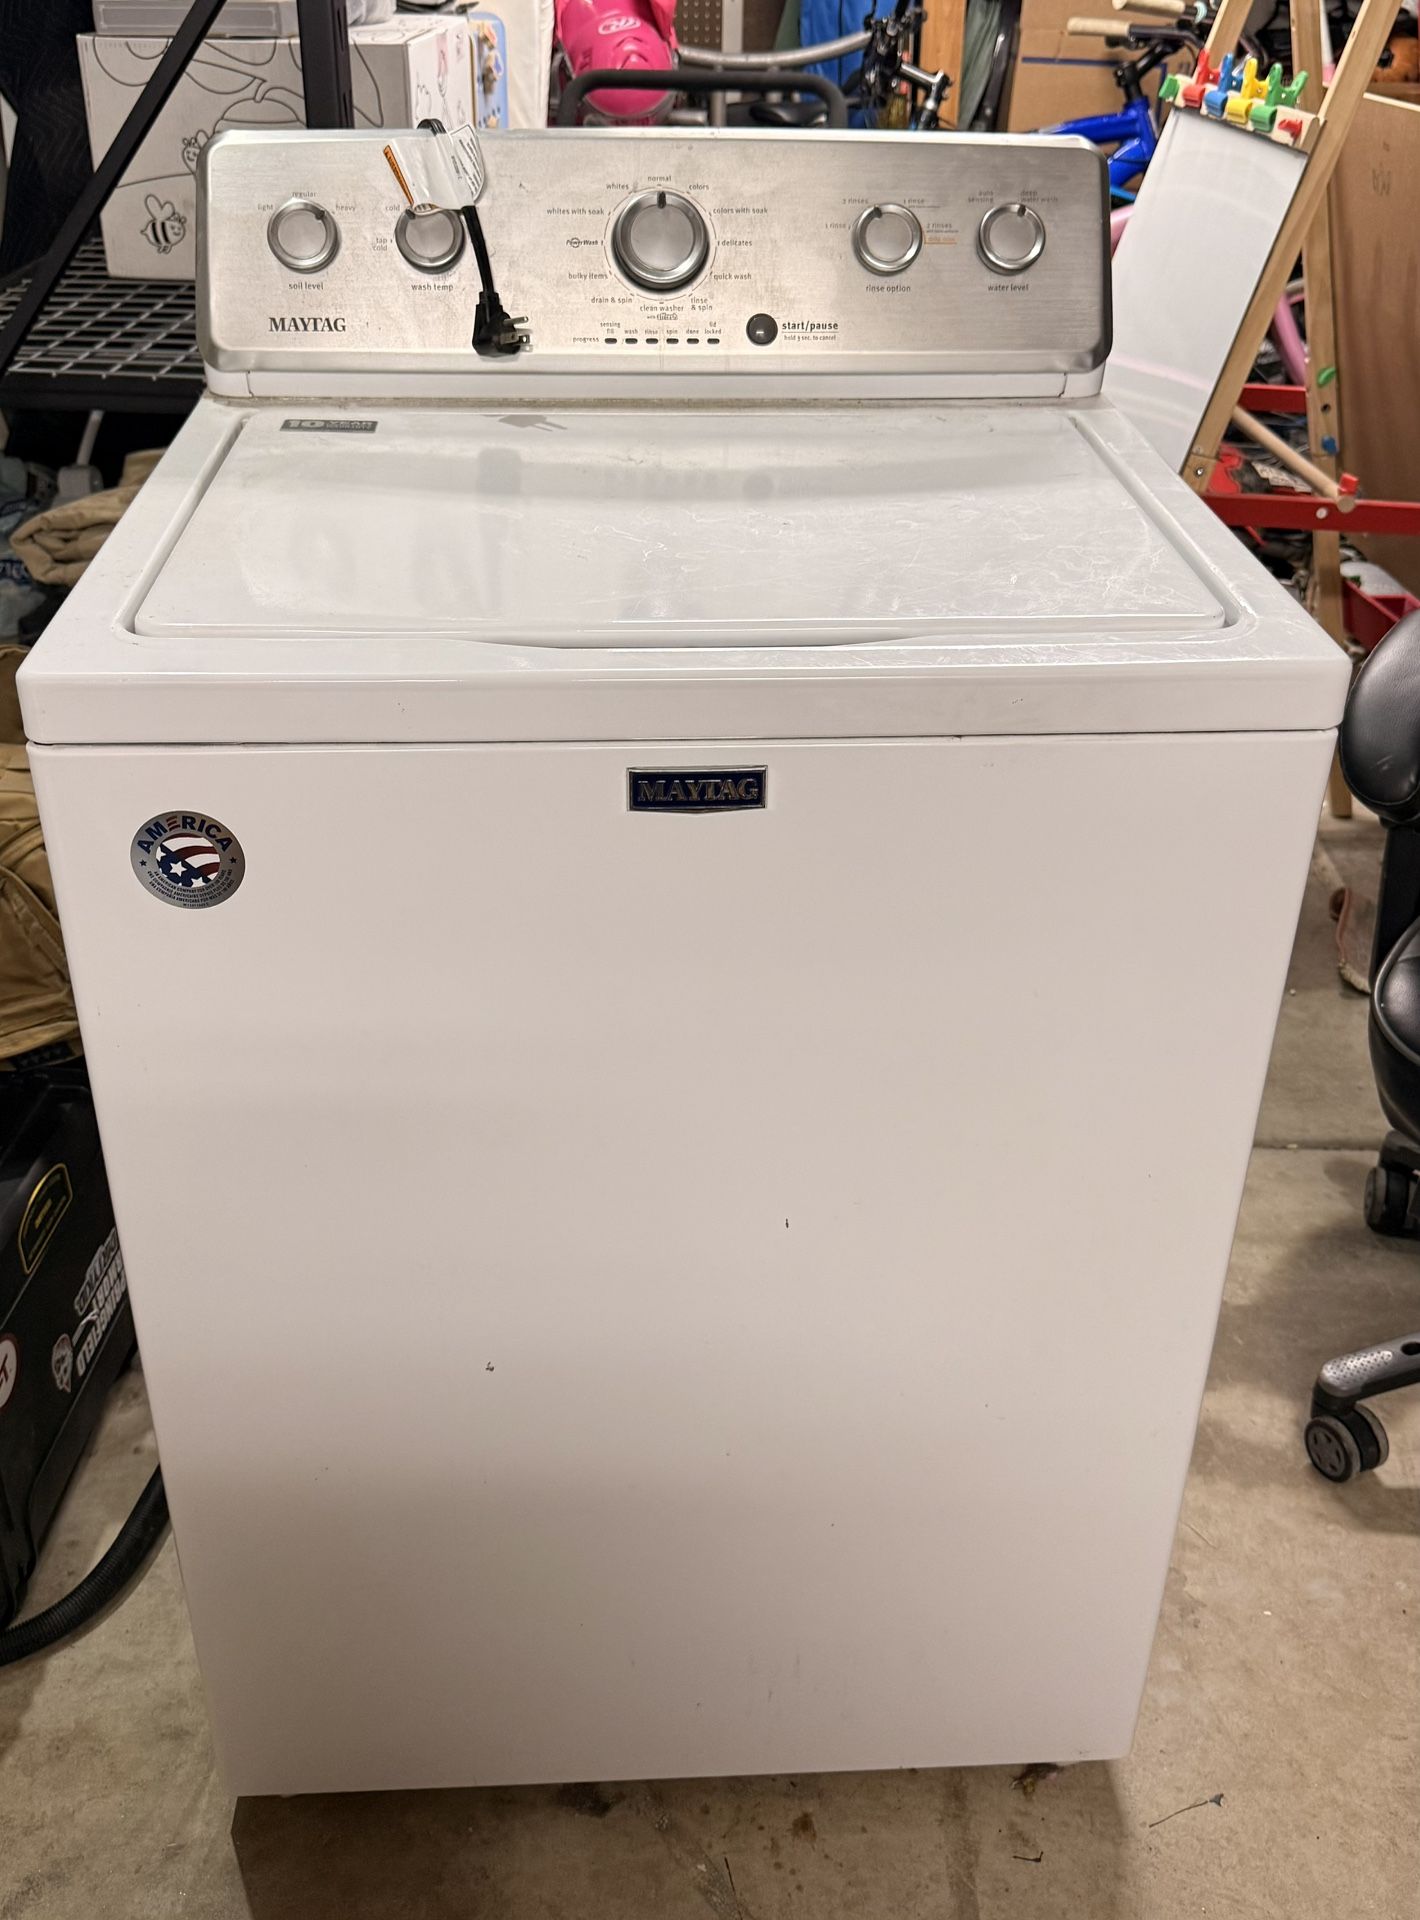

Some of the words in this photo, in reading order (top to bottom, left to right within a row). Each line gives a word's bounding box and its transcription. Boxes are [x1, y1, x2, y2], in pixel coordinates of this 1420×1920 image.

[335, 204, 356, 212] heavy
[288, 282, 303, 290] soil
[305, 282, 324, 290] level
[433, 284, 454, 292] temp
[268, 317, 346, 332] MAYTAG
[782, 320, 839, 332] start/pause
[638, 778, 758, 801] MAYTAG
[137, 815, 232, 854] AMERICA
